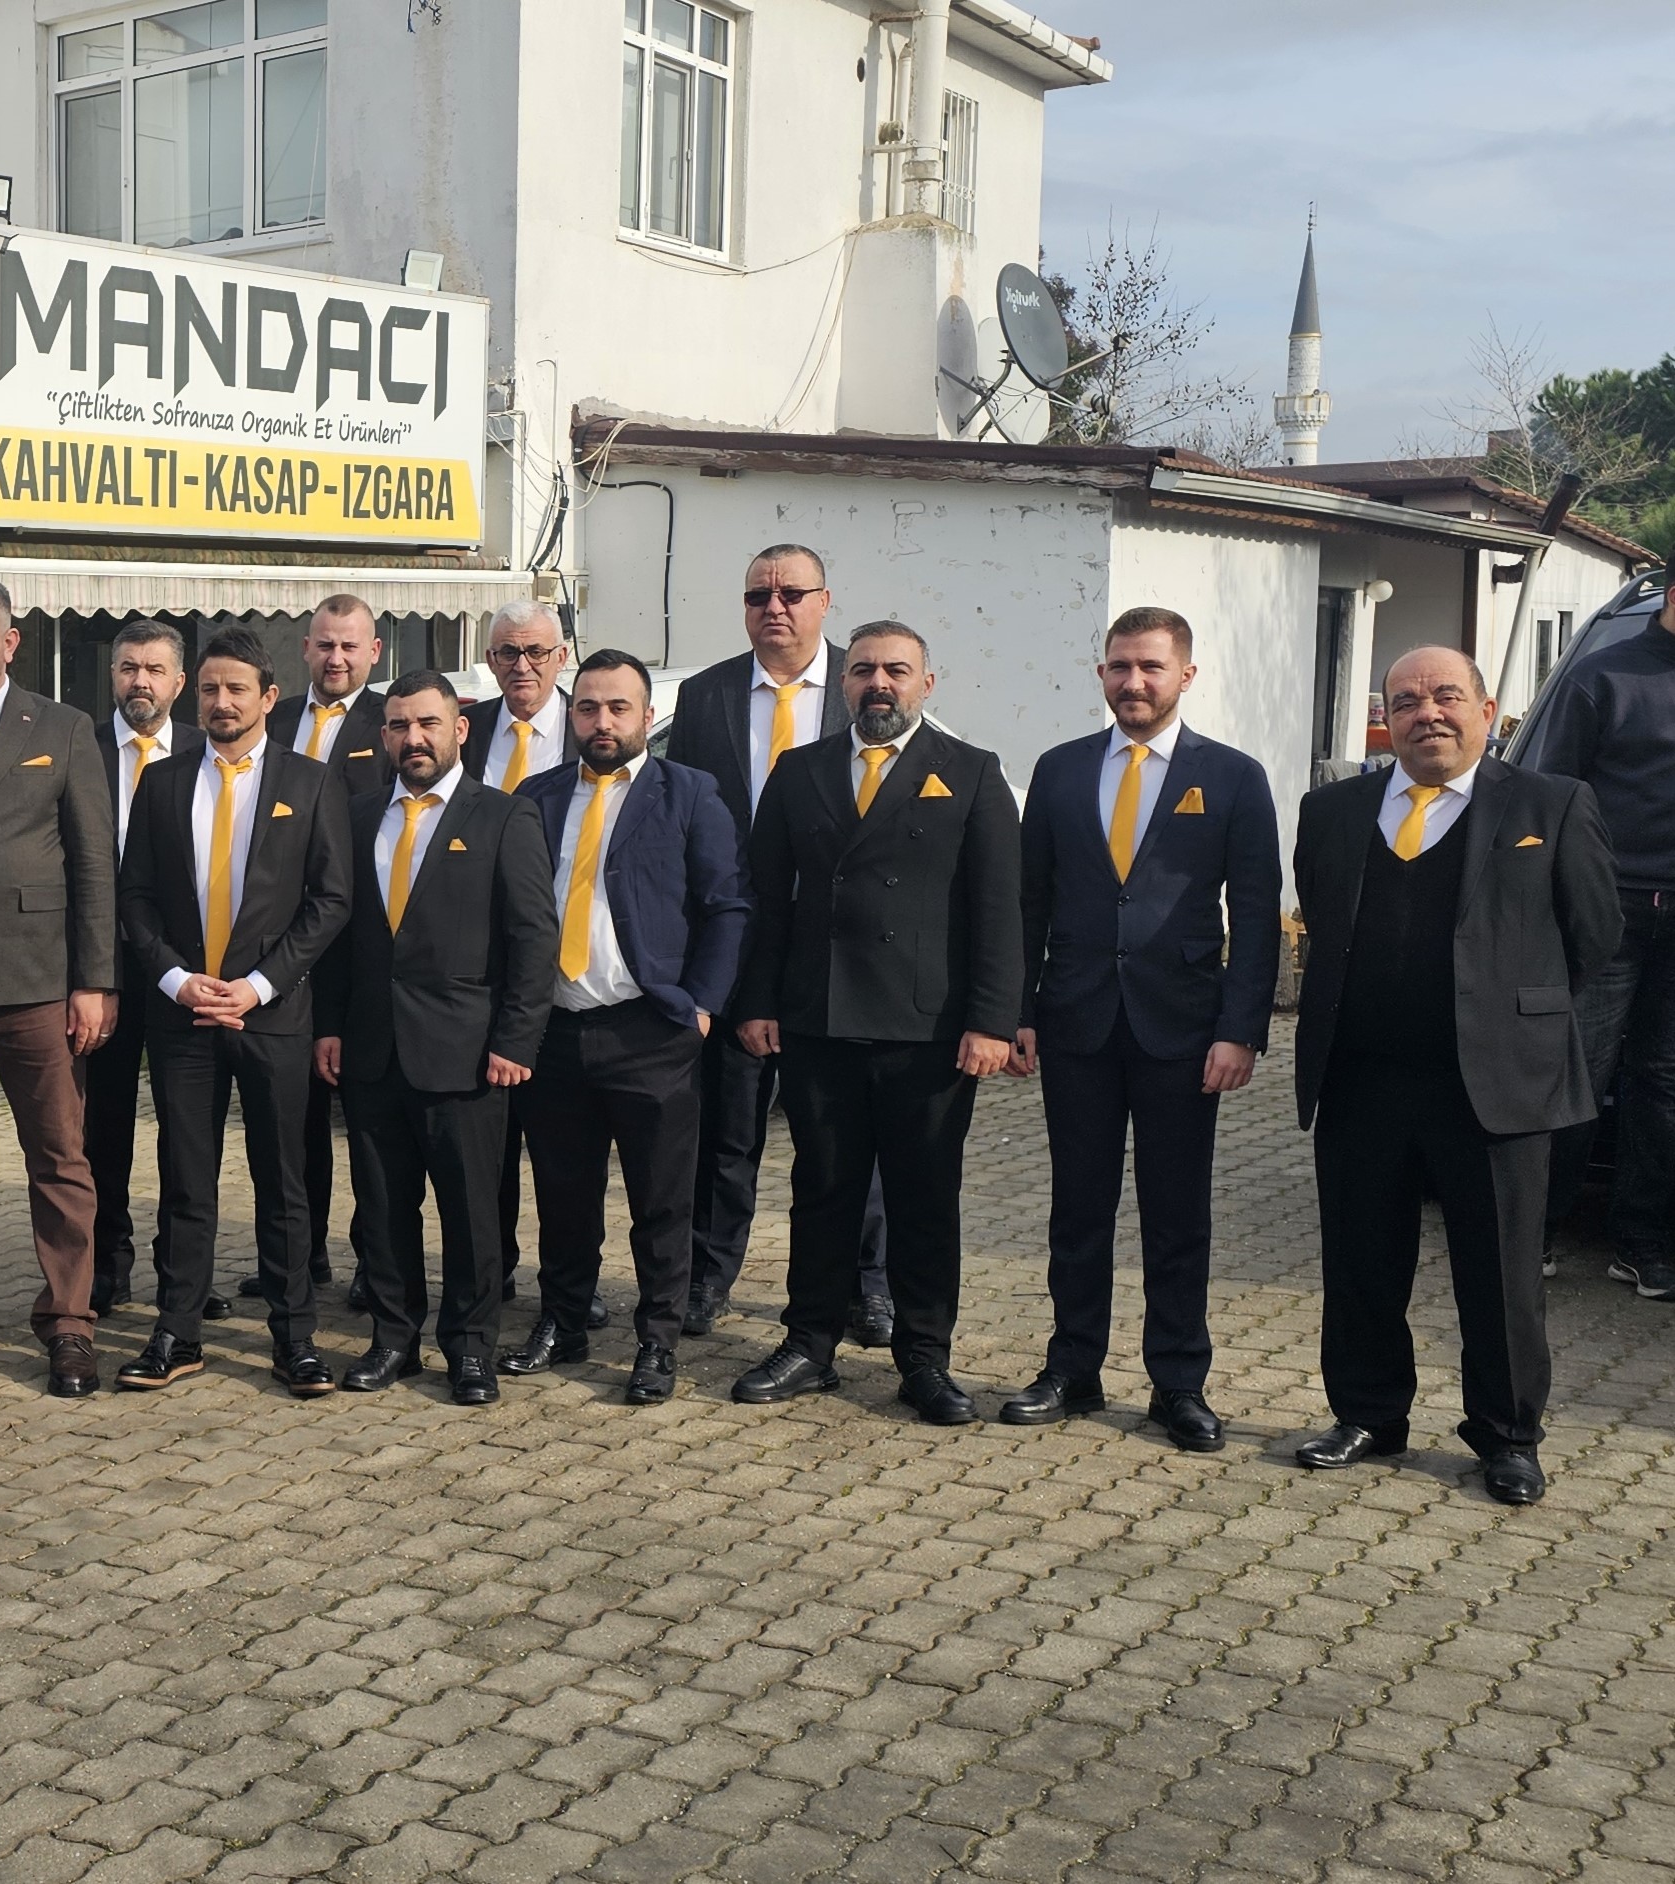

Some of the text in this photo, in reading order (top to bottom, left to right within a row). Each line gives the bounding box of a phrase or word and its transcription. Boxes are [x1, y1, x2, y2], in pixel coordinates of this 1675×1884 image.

[0, 250, 450, 421] MANDACI
[152, 401, 234, 432] Sofranıza
[241, 410, 307, 443] Organik
[314, 417, 332, 440] Et
